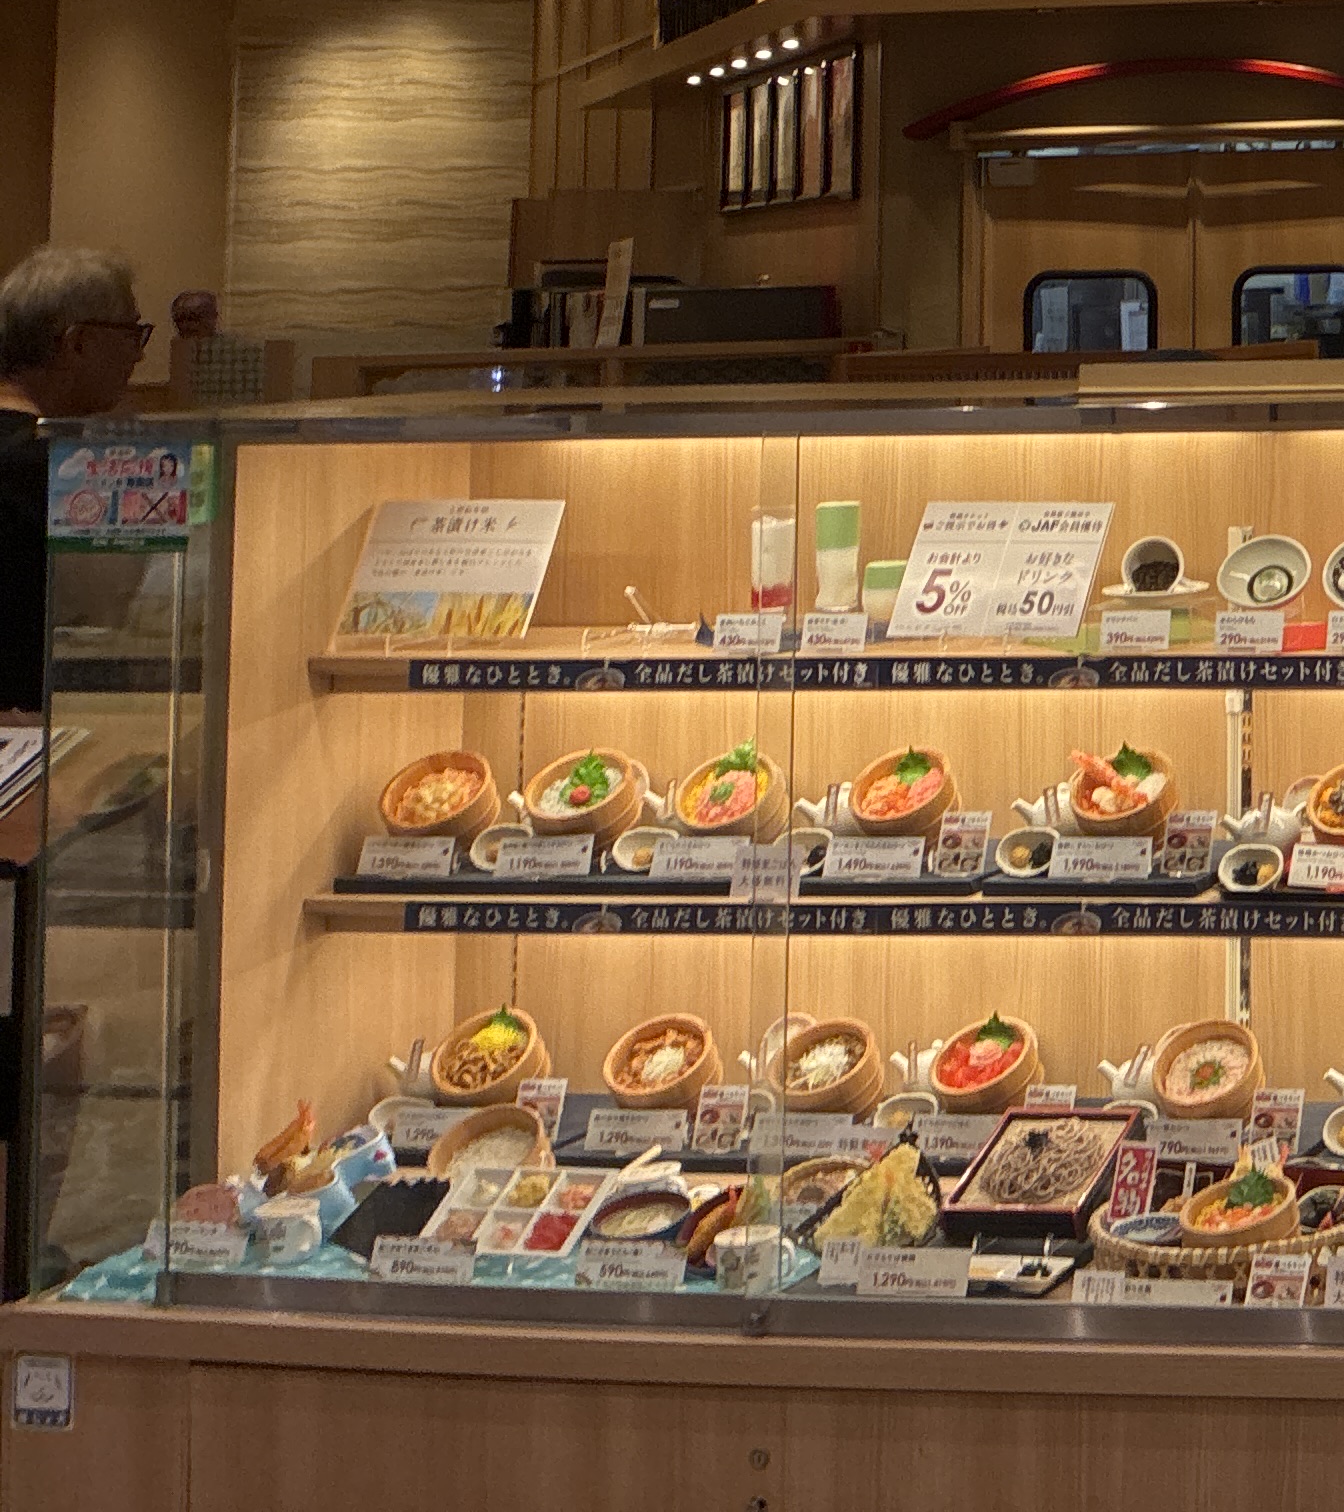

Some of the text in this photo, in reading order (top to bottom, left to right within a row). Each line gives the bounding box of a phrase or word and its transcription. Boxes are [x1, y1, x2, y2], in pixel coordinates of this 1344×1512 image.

[422, 663, 571, 686] 優雅なひととき。
[891, 662, 1044, 684] 優雅なひととき。
[418, 905, 568, 928] 優雅なひととき。
[890, 905, 1046, 929] 優雅なひととき。
